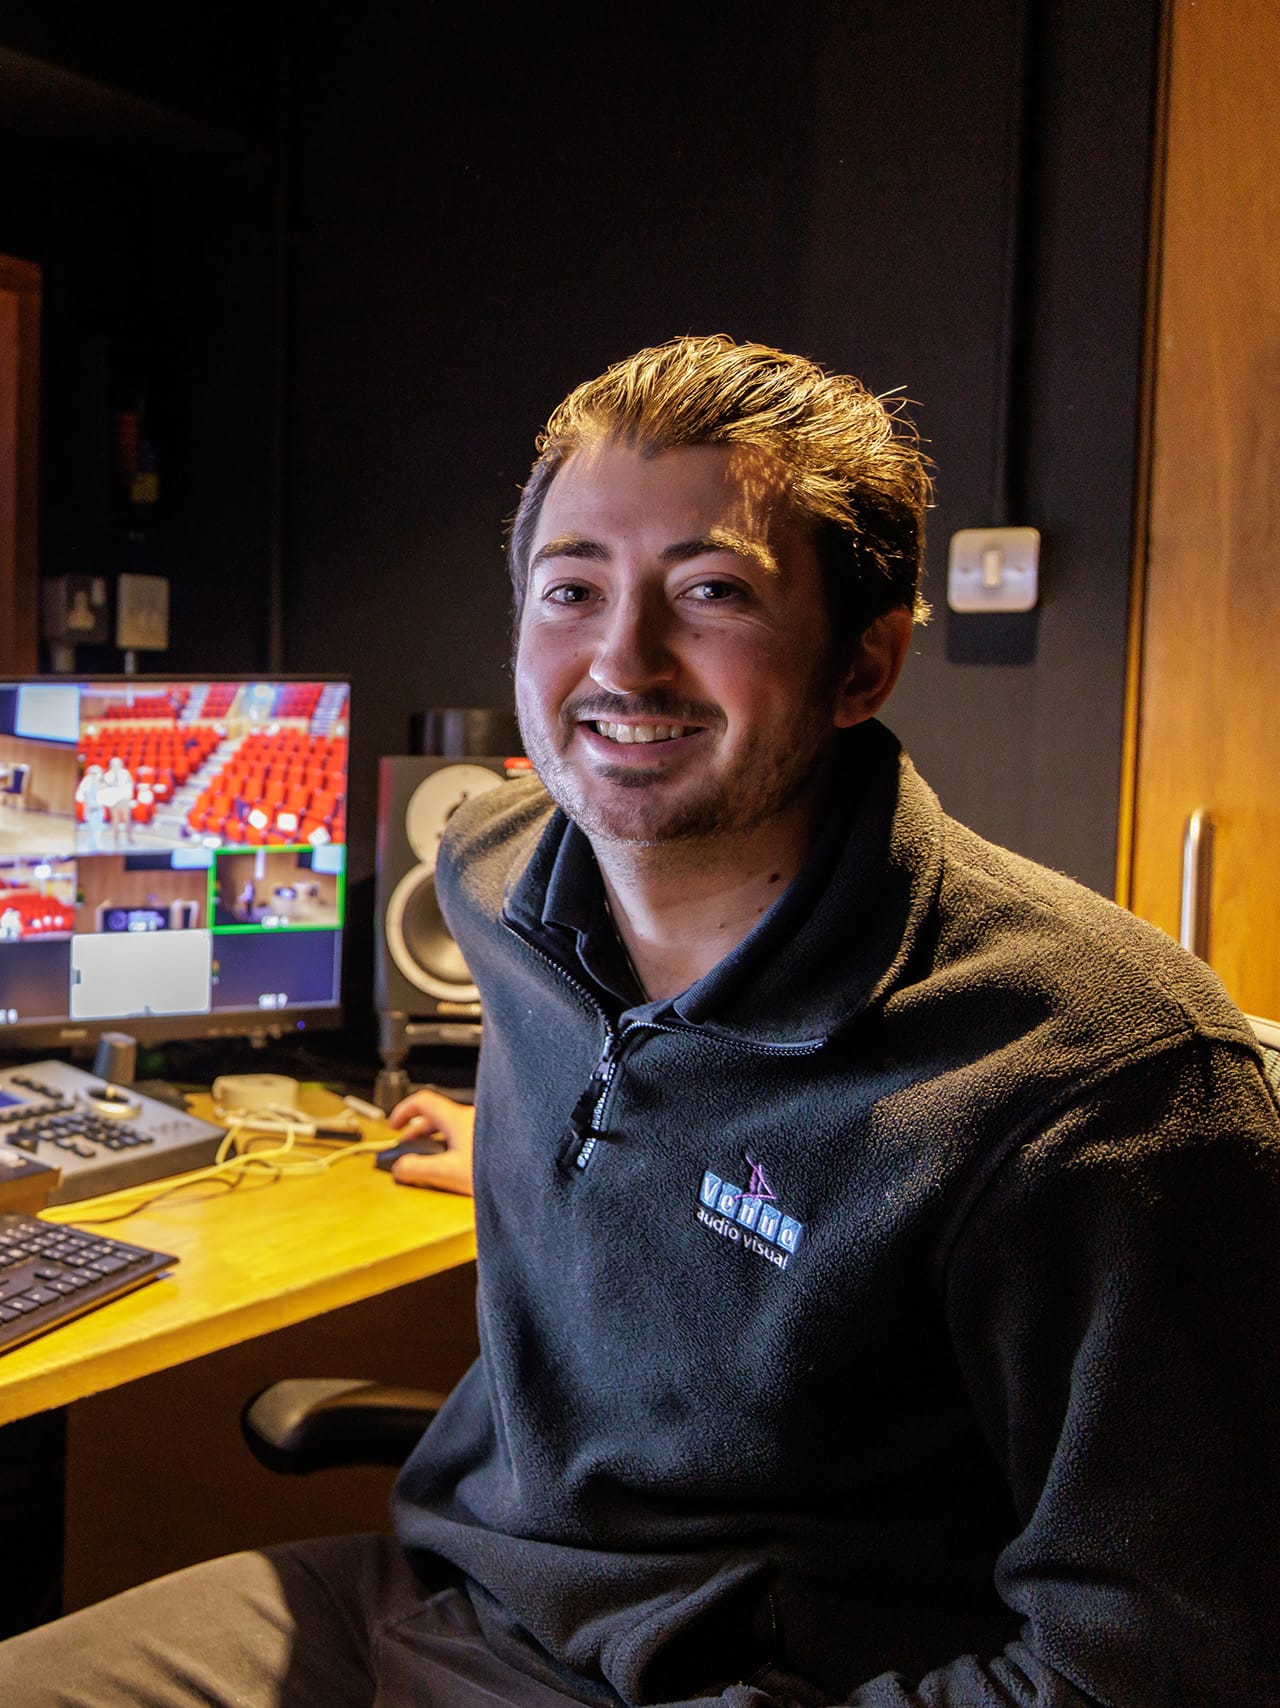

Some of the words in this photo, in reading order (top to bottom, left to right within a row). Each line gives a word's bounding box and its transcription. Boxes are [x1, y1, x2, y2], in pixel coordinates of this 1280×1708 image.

[696, 1207, 740, 1241] audio
[743, 1234, 789, 1271] visual
[704, 1176, 794, 1247] Venue
